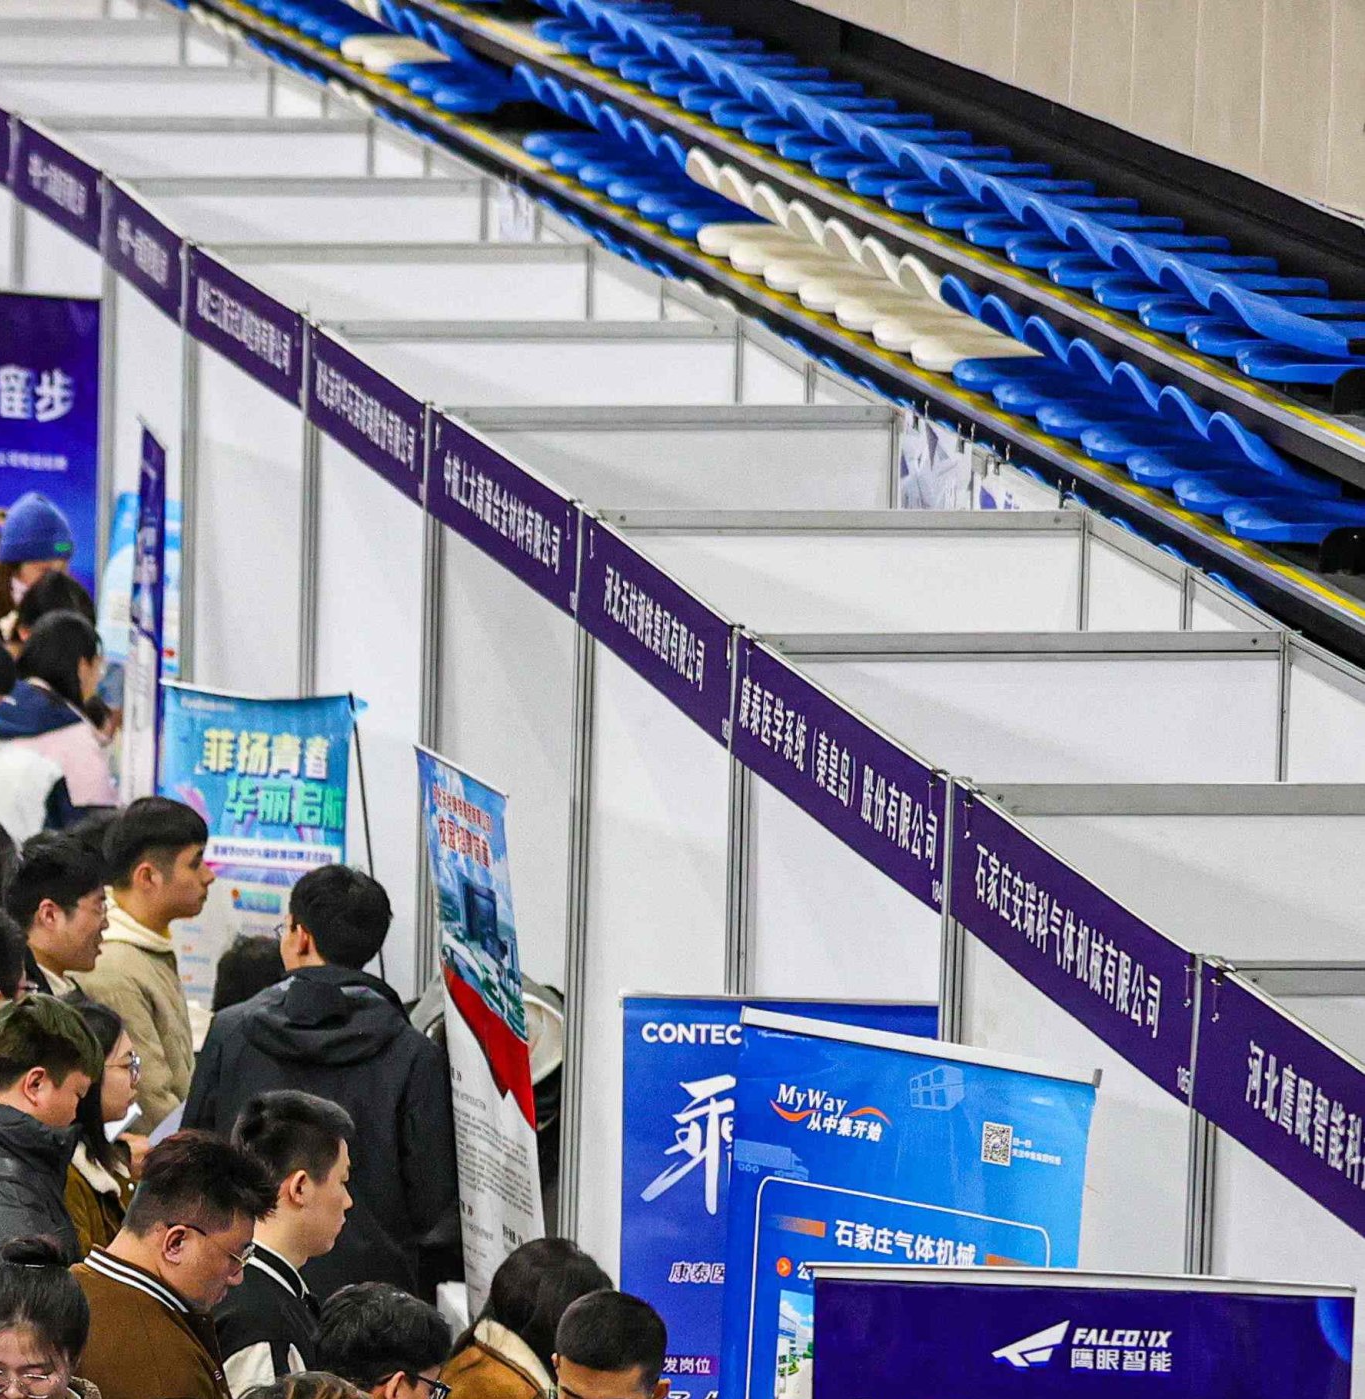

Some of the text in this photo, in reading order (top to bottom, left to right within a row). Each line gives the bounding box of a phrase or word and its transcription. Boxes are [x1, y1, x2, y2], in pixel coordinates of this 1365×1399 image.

[443, 456, 561, 574] 中航上大高温合金材料有限公司
[603, 565, 707, 692] 河北天柱钢铁集团有限公司
[203, 728, 330, 780] 菲扬青春
[738, 676, 938, 871] 康泰医学系统（秦皇岛）股份有限公司
[223, 778, 345, 831] 华丽启航
[975, 842, 1163, 1038] 石家庄安瑞科气体机械有限公司
[642, 1022, 742, 1045] CONTEC
[777, 1083, 848, 1118] MyWay
[1247, 1038, 1365, 1188] 河北鹰眼智能科
[807, 1108, 884, 1142] 从中集开始
[834, 1219, 976, 1267] 石家庄气体机械
[797, 1261, 814, 1281] 公
[1070, 1348, 1173, 1372] 鹰眼智能
[1072, 1328, 1172, 1349] FALCONIX
[663, 1357, 711, 1374] 发岗位
